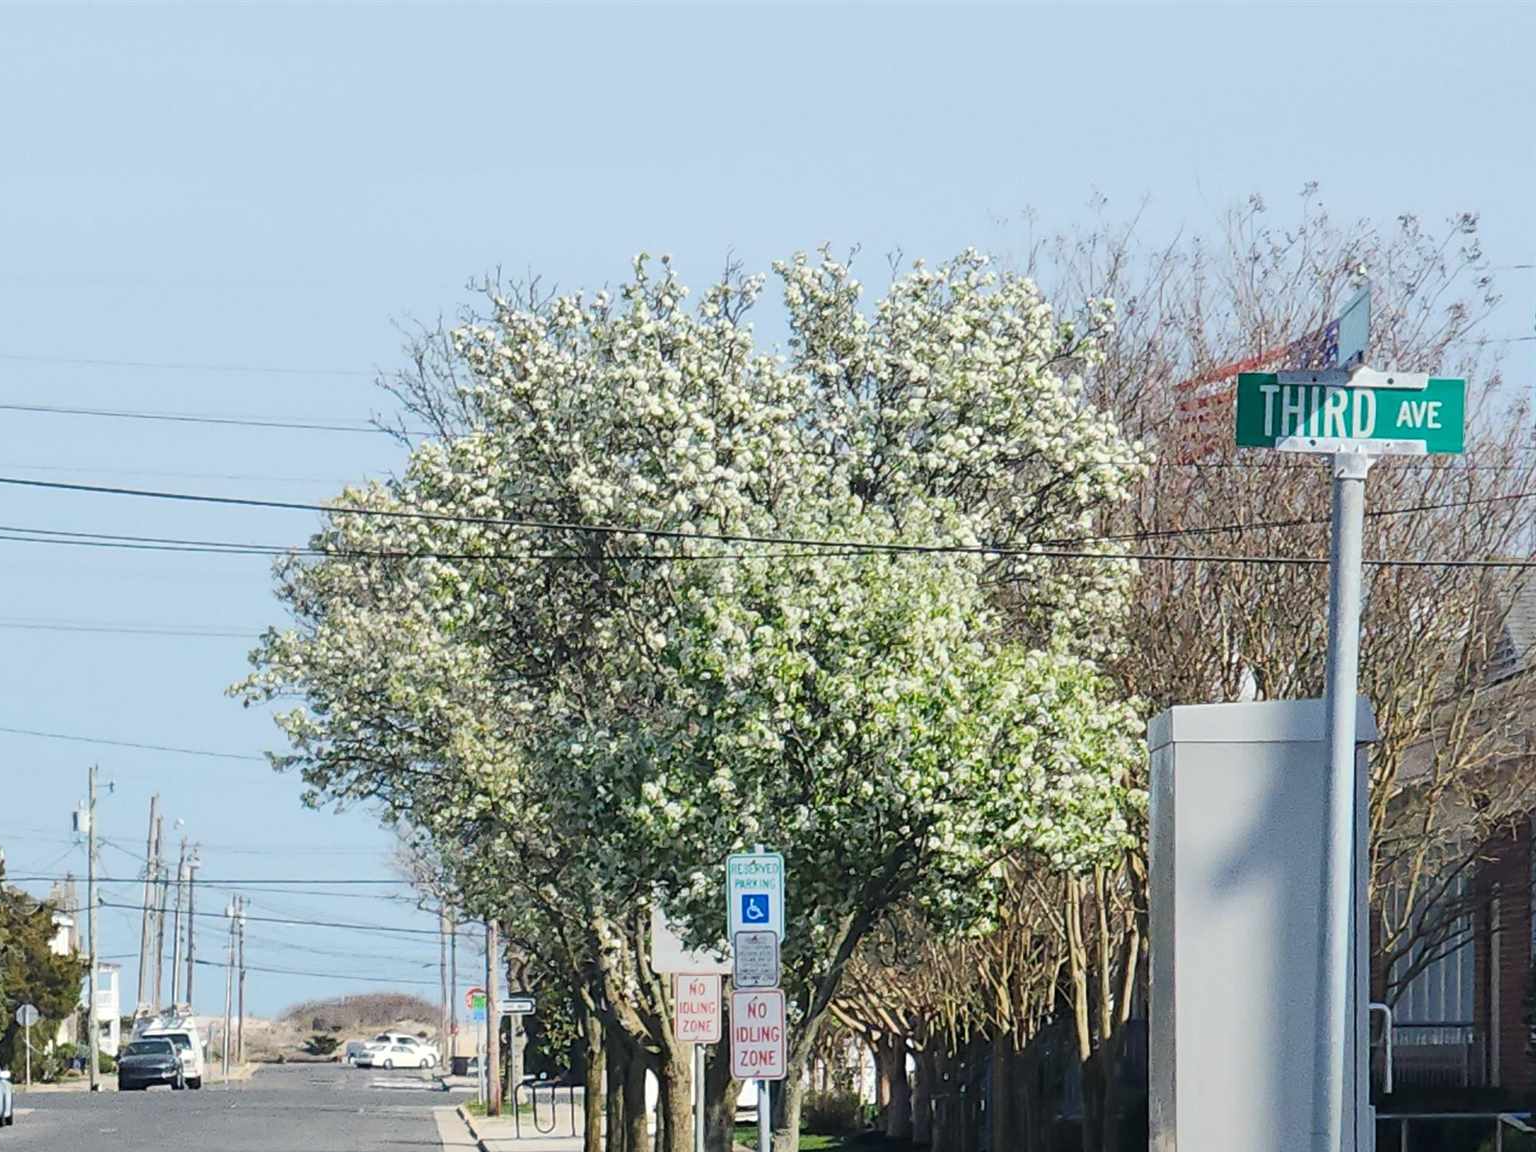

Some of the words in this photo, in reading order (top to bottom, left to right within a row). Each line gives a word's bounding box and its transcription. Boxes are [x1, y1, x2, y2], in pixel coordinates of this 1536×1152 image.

[1259, 385, 1377, 439] THIRD
[1396, 400, 1443, 429] AVE
[731, 863, 778, 876] RESERVED
[734, 878, 776, 889] PARKING
[689, 983, 705, 996] NO
[679, 1002, 716, 1015] IDLING
[747, 1002, 767, 1018] NO
[682, 1020, 713, 1033] ZONE
[736, 1026, 781, 1043] IDLING
[740, 1050, 777, 1067] ZONE
